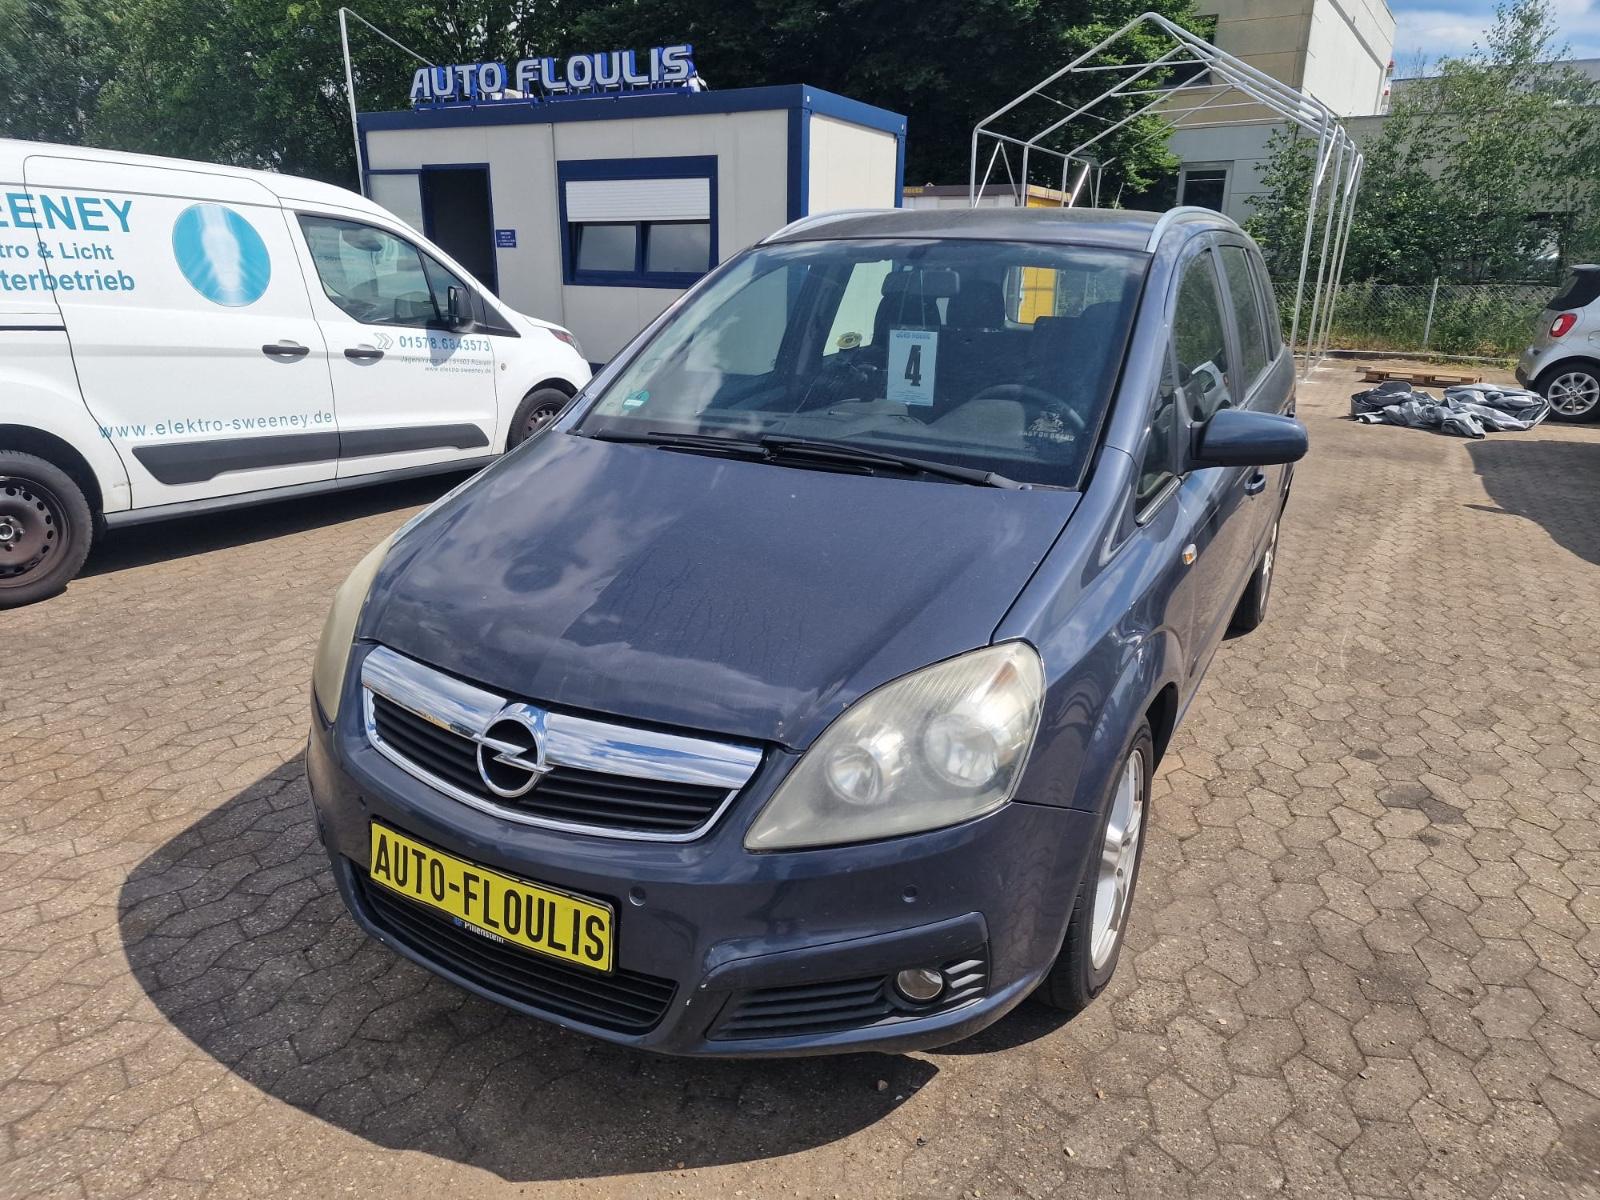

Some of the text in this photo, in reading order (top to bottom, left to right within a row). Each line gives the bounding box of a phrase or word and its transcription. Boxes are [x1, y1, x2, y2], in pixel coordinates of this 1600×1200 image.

[409, 44, 692, 99] AUTO FLOULIS
[0, 192, 132, 233] ENEY
[37, 241, 54, 259] &
[59, 242, 114, 260] Licht
[399, 335, 490, 352] 01578.6843573
[904, 345, 921, 387] 4
[98, 409, 333, 439] www.elektro-sweeney.de
[374, 834, 605, 962] AUTO-FLOULIS
